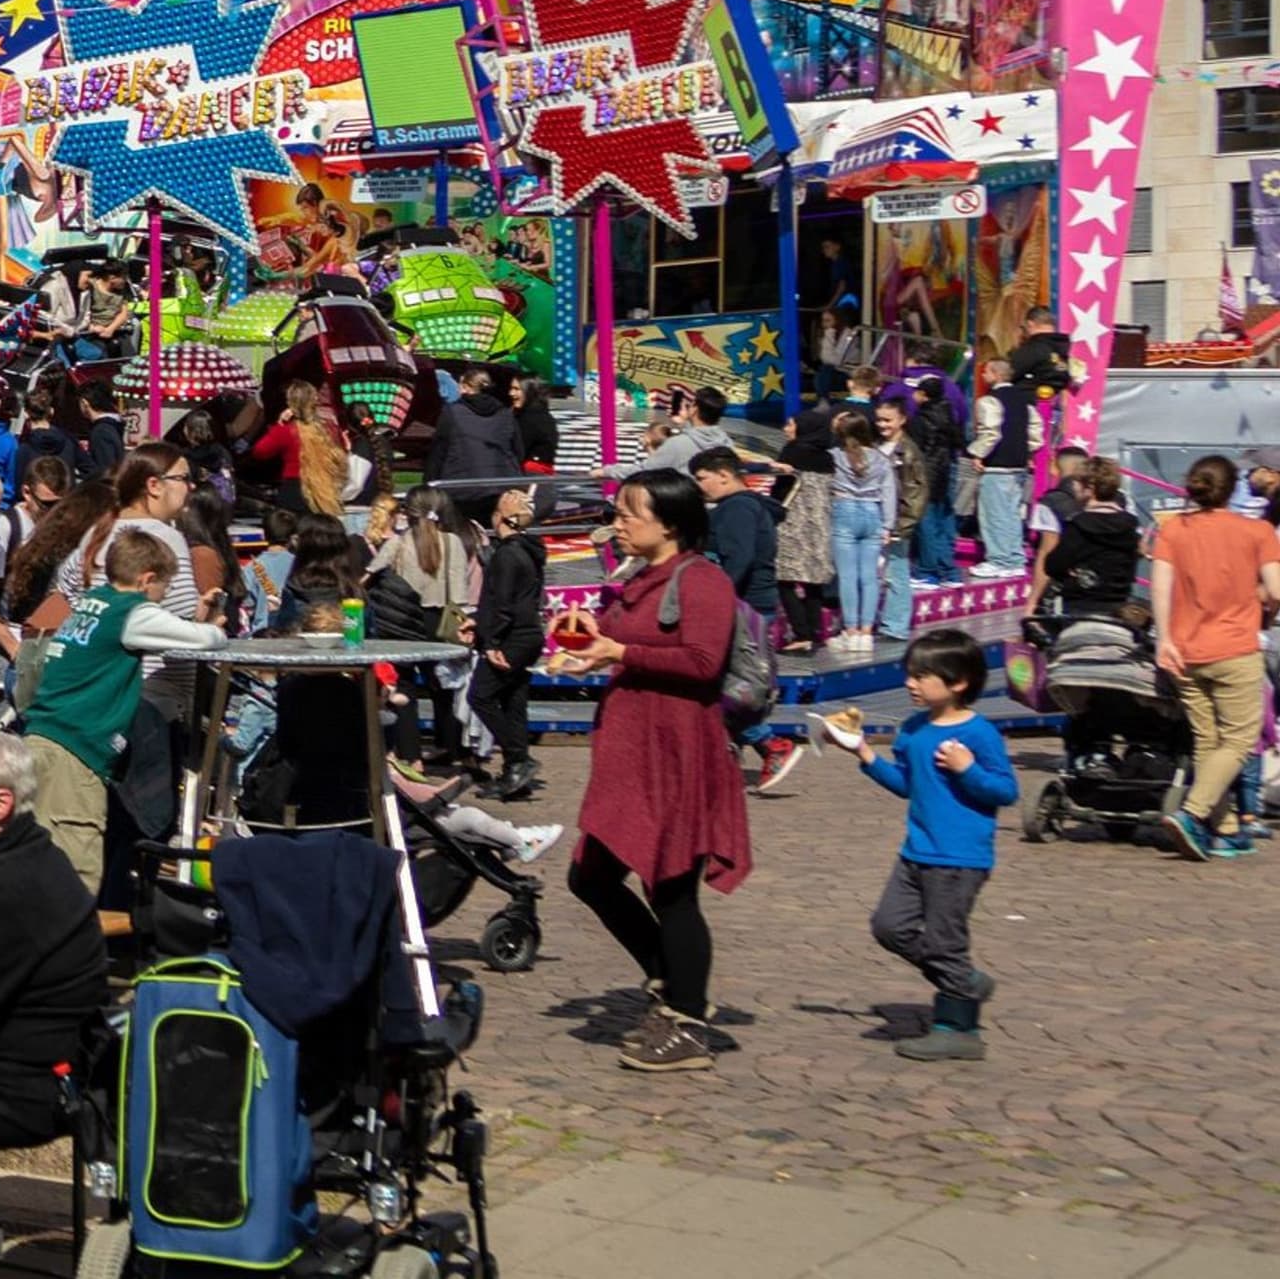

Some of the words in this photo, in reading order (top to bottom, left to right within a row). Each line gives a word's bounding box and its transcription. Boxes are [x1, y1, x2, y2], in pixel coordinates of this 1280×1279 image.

[24, 57, 167, 122] BREAK
[136, 74, 308, 145] DANCER
[377, 123, 481, 147] R.Schramm
[618, 339, 713, 381] Operator
